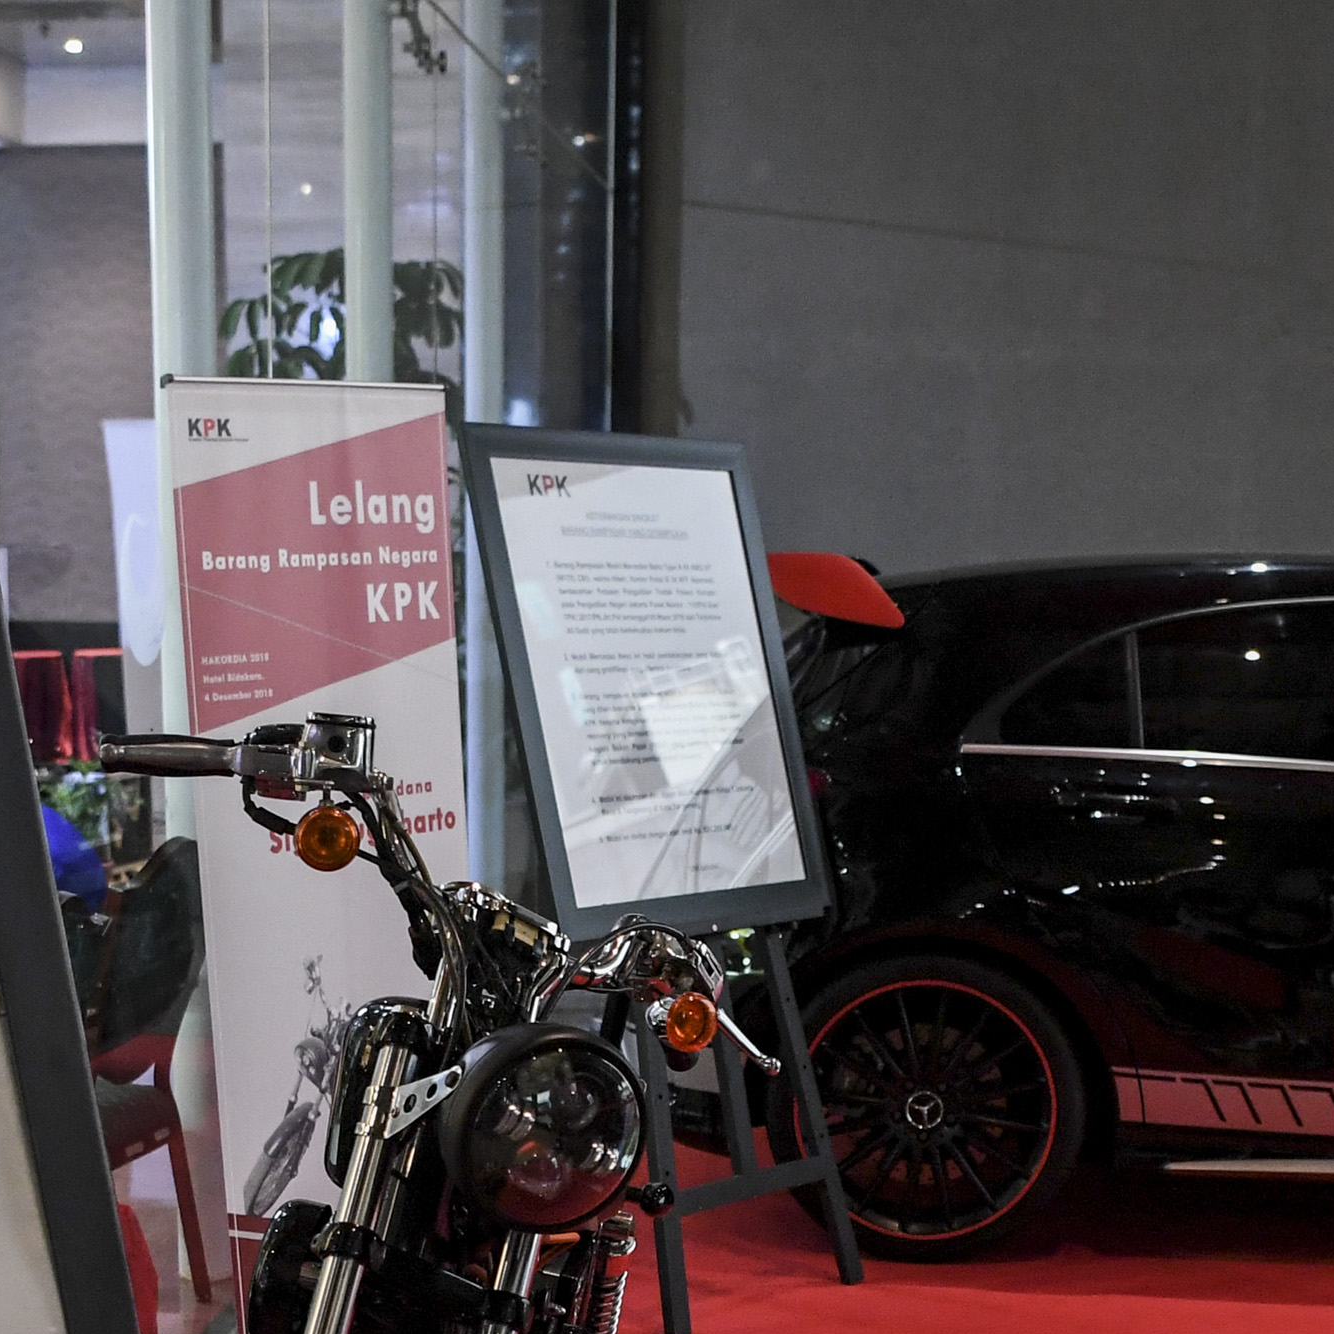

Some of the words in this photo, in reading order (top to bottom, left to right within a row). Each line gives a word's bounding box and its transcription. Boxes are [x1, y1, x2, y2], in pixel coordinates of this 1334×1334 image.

[187, 418, 232, 437] KPK
[527, 474, 571, 497] KPK
[309, 479, 435, 534] Lelang
[202, 551, 271, 573] Barang
[278, 548, 373, 571] Rampasan
[378, 546, 438, 569] Negara
[366, 581, 441, 623] KPK
